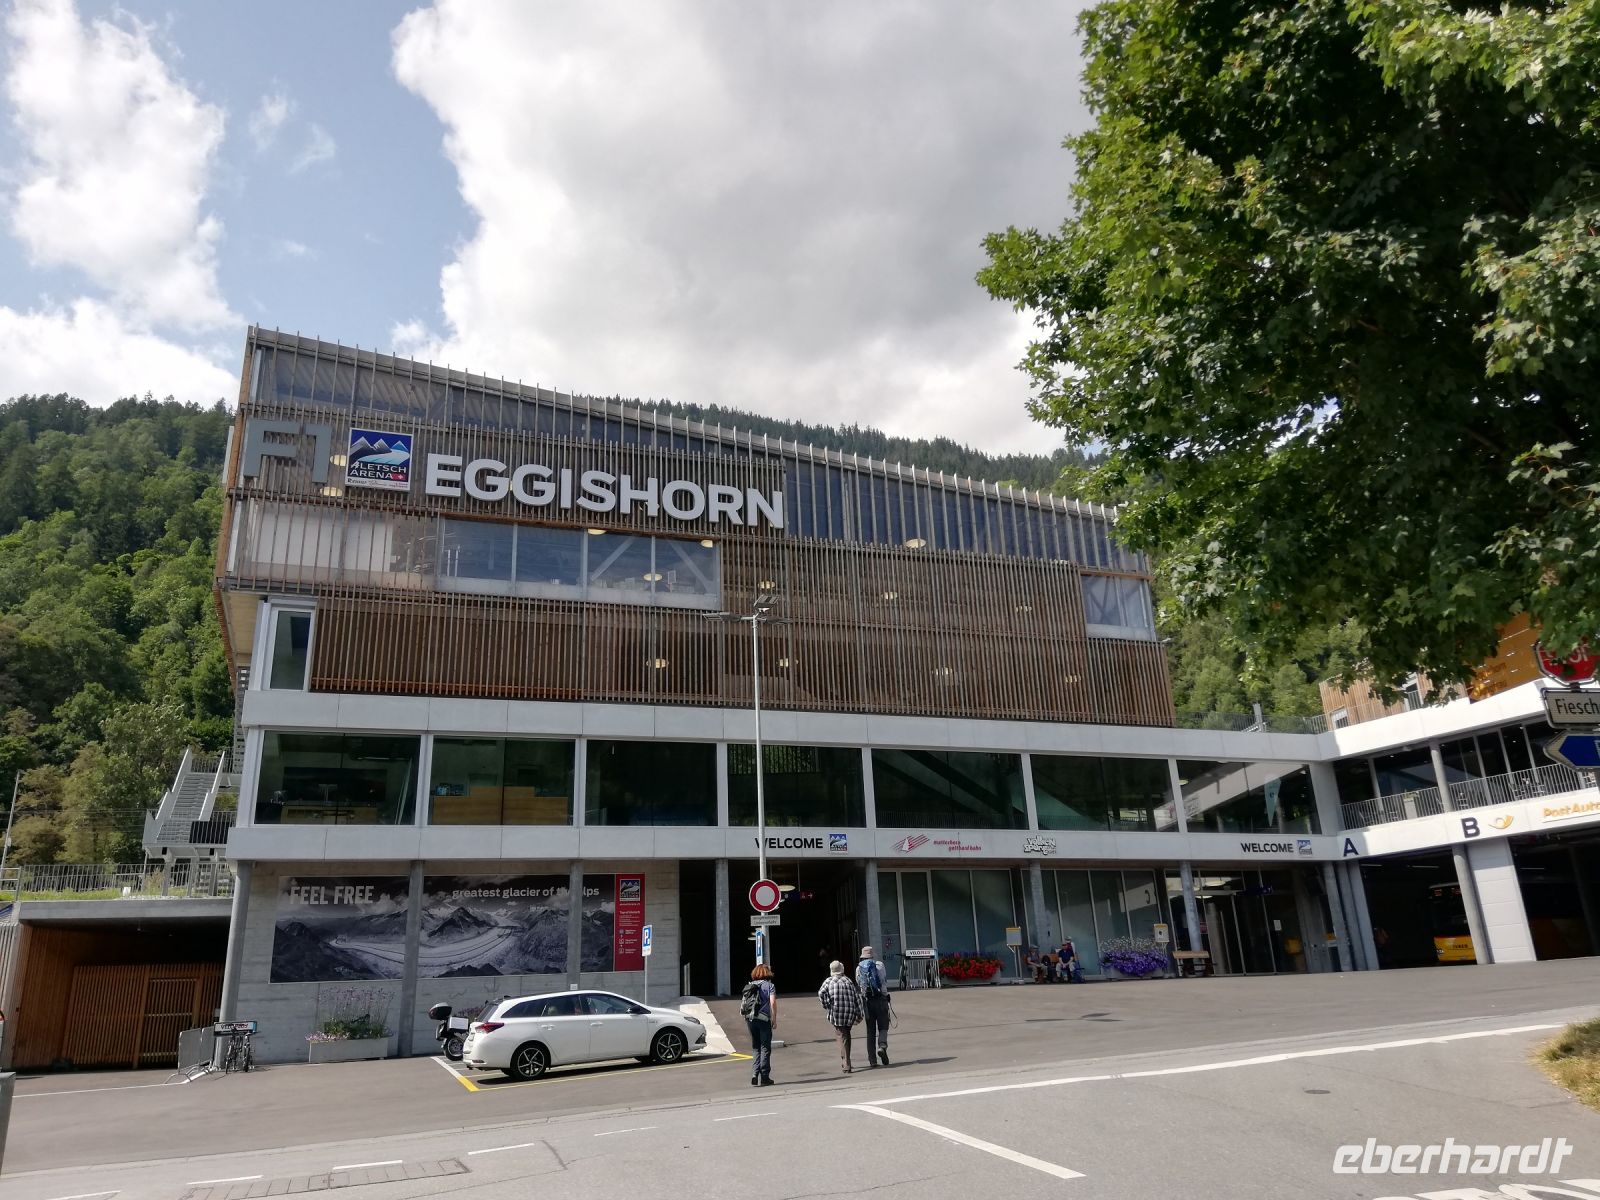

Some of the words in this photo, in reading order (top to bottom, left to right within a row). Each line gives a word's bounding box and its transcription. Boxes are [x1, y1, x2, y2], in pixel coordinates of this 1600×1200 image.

[350, 460, 407, 474] ALETSCH
[349, 469, 394, 480] ARENA
[425, 452, 784, 530] EGGISHORN
[1460, 817, 1480, 839] B
[754, 837, 824, 849] WELCOME
[1240, 842, 1294, 853] WELCOME
[1343, 837, 1359, 857] A
[290, 885, 329, 905] FEEL
[333, 885, 375, 904] FREE
[452, 888, 500, 899] greatest
[502, 887, 540, 899] glacier
[542, 886, 555, 896] of
[582, 886, 600, 897] lps
